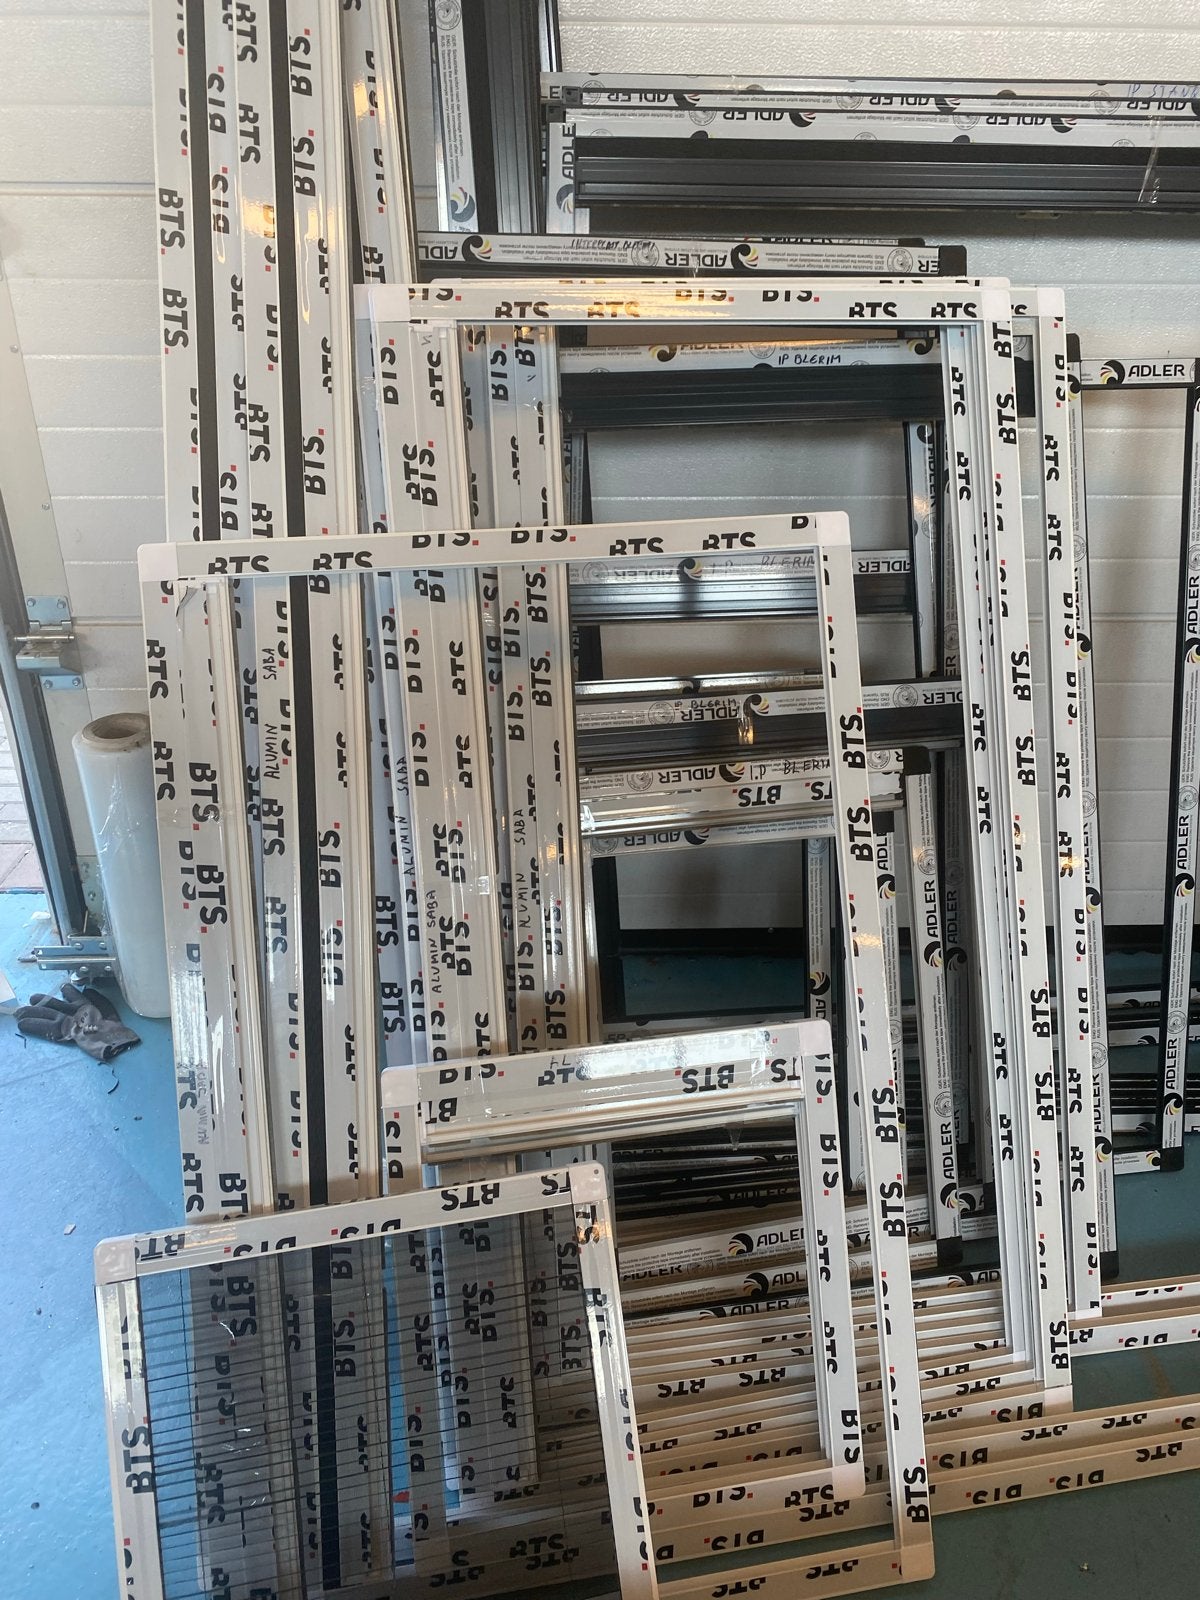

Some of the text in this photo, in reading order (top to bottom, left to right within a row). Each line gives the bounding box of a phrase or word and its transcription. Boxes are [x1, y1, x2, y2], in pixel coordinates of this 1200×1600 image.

[562, 123, 576, 179] ADLE
[418, 245, 457, 260] ADL
[665, 253, 727, 268] ADLER
[794, 354, 841, 365] BLERIM
[1128, 364, 1185, 378] ADLER
[1187, 575, 1199, 634] ADLER
[262, 648, 277, 680] SABA
[681, 705, 740, 721] ADLER
[923, 691, 963, 704] DLER
[840, 707, 866, 769] BTS.
[658, 766, 716, 784] ADLER
[847, 799, 874, 862] BTS.
[1177, 814, 1190, 870] ADLER
[924, 879, 939, 938] ADLER
[426, 889, 441, 994] ALUMIN SABA
[1165, 1037, 1178, 1090] ADLER
[872, 1079, 899, 1143] BTS.
[940, 1121, 954, 1180] ADLER
[880, 1173, 906, 1237] BTS.
[756, 1228, 804, 1247] ADLE
[772, 1270, 808, 1286] ADL
[904, 1458, 930, 1522] BTS.
